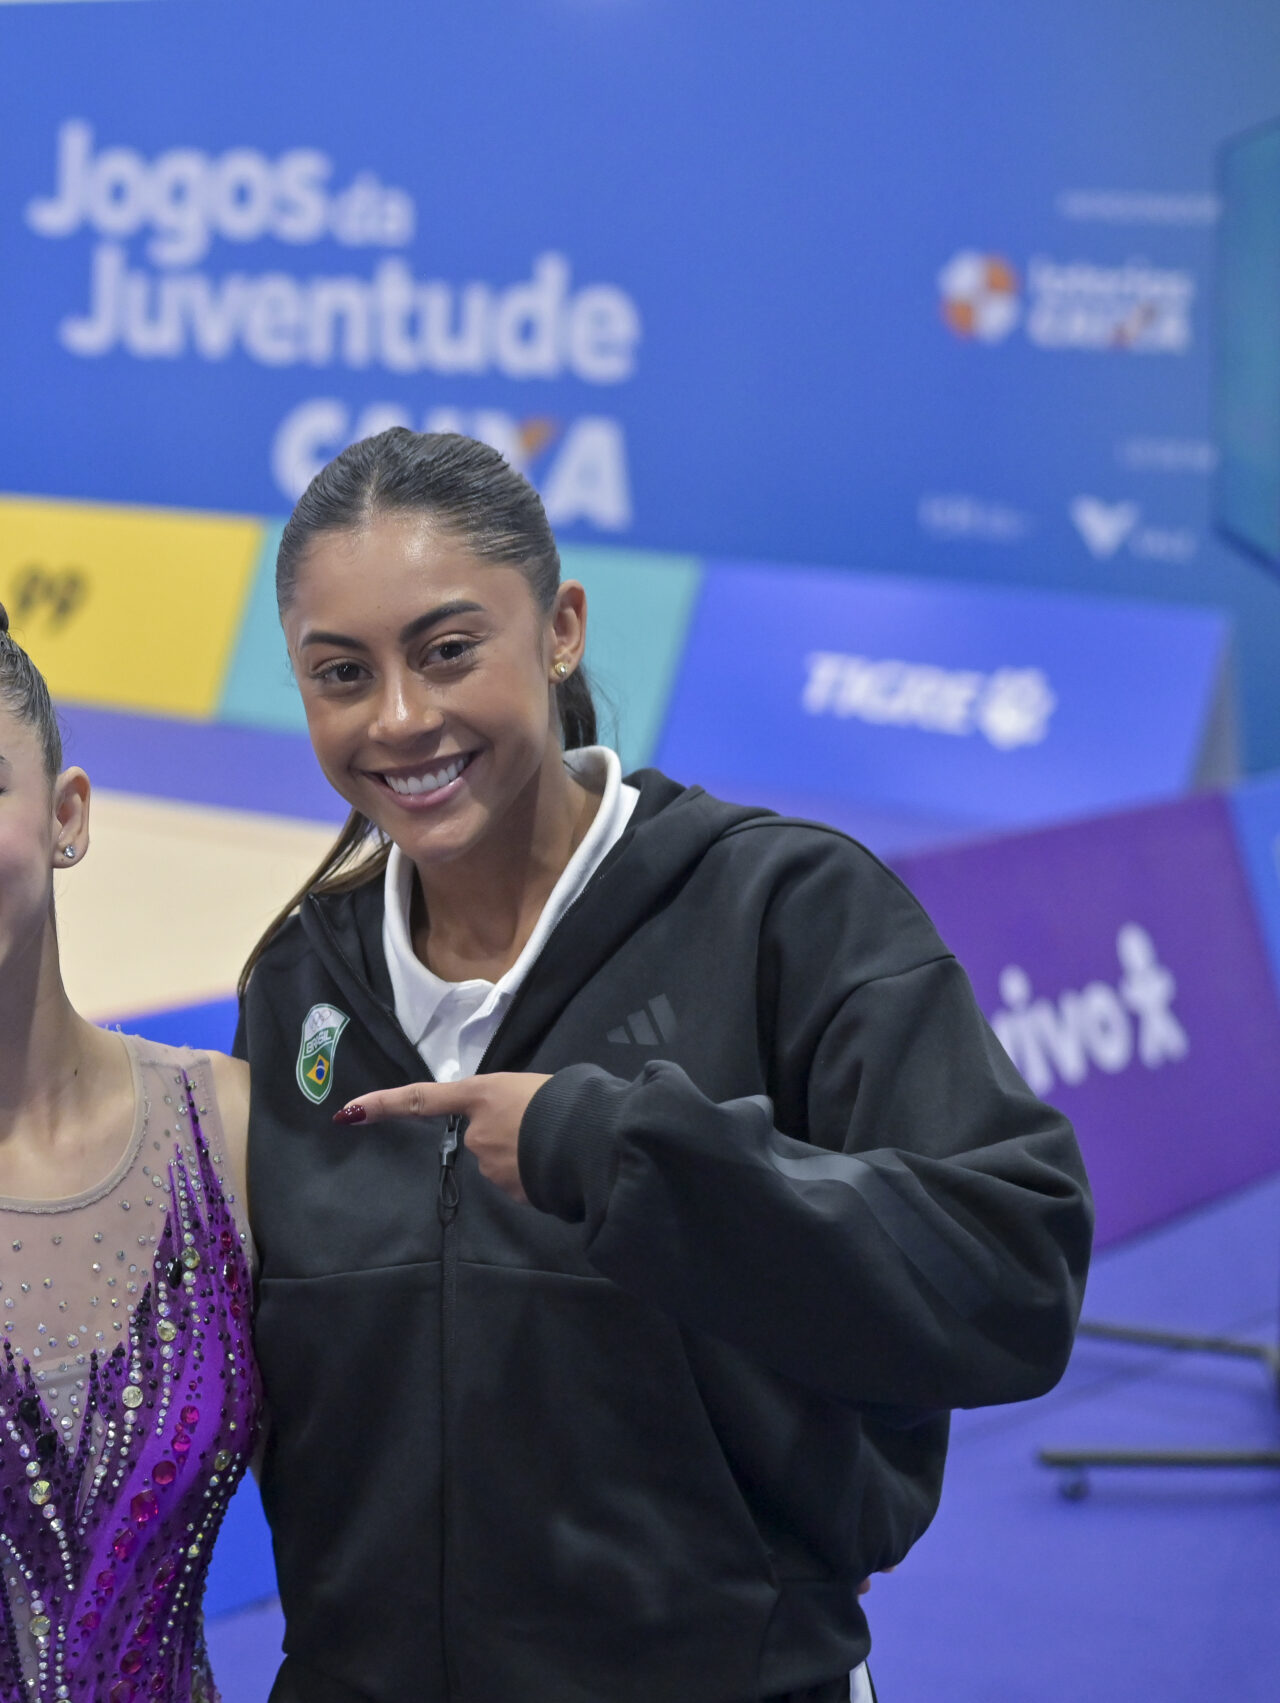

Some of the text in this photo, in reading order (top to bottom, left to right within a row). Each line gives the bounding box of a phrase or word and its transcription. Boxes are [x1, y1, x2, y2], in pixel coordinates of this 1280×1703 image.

[28, 121, 414, 267] Jogos da
[63, 243, 638, 384] Juventude
